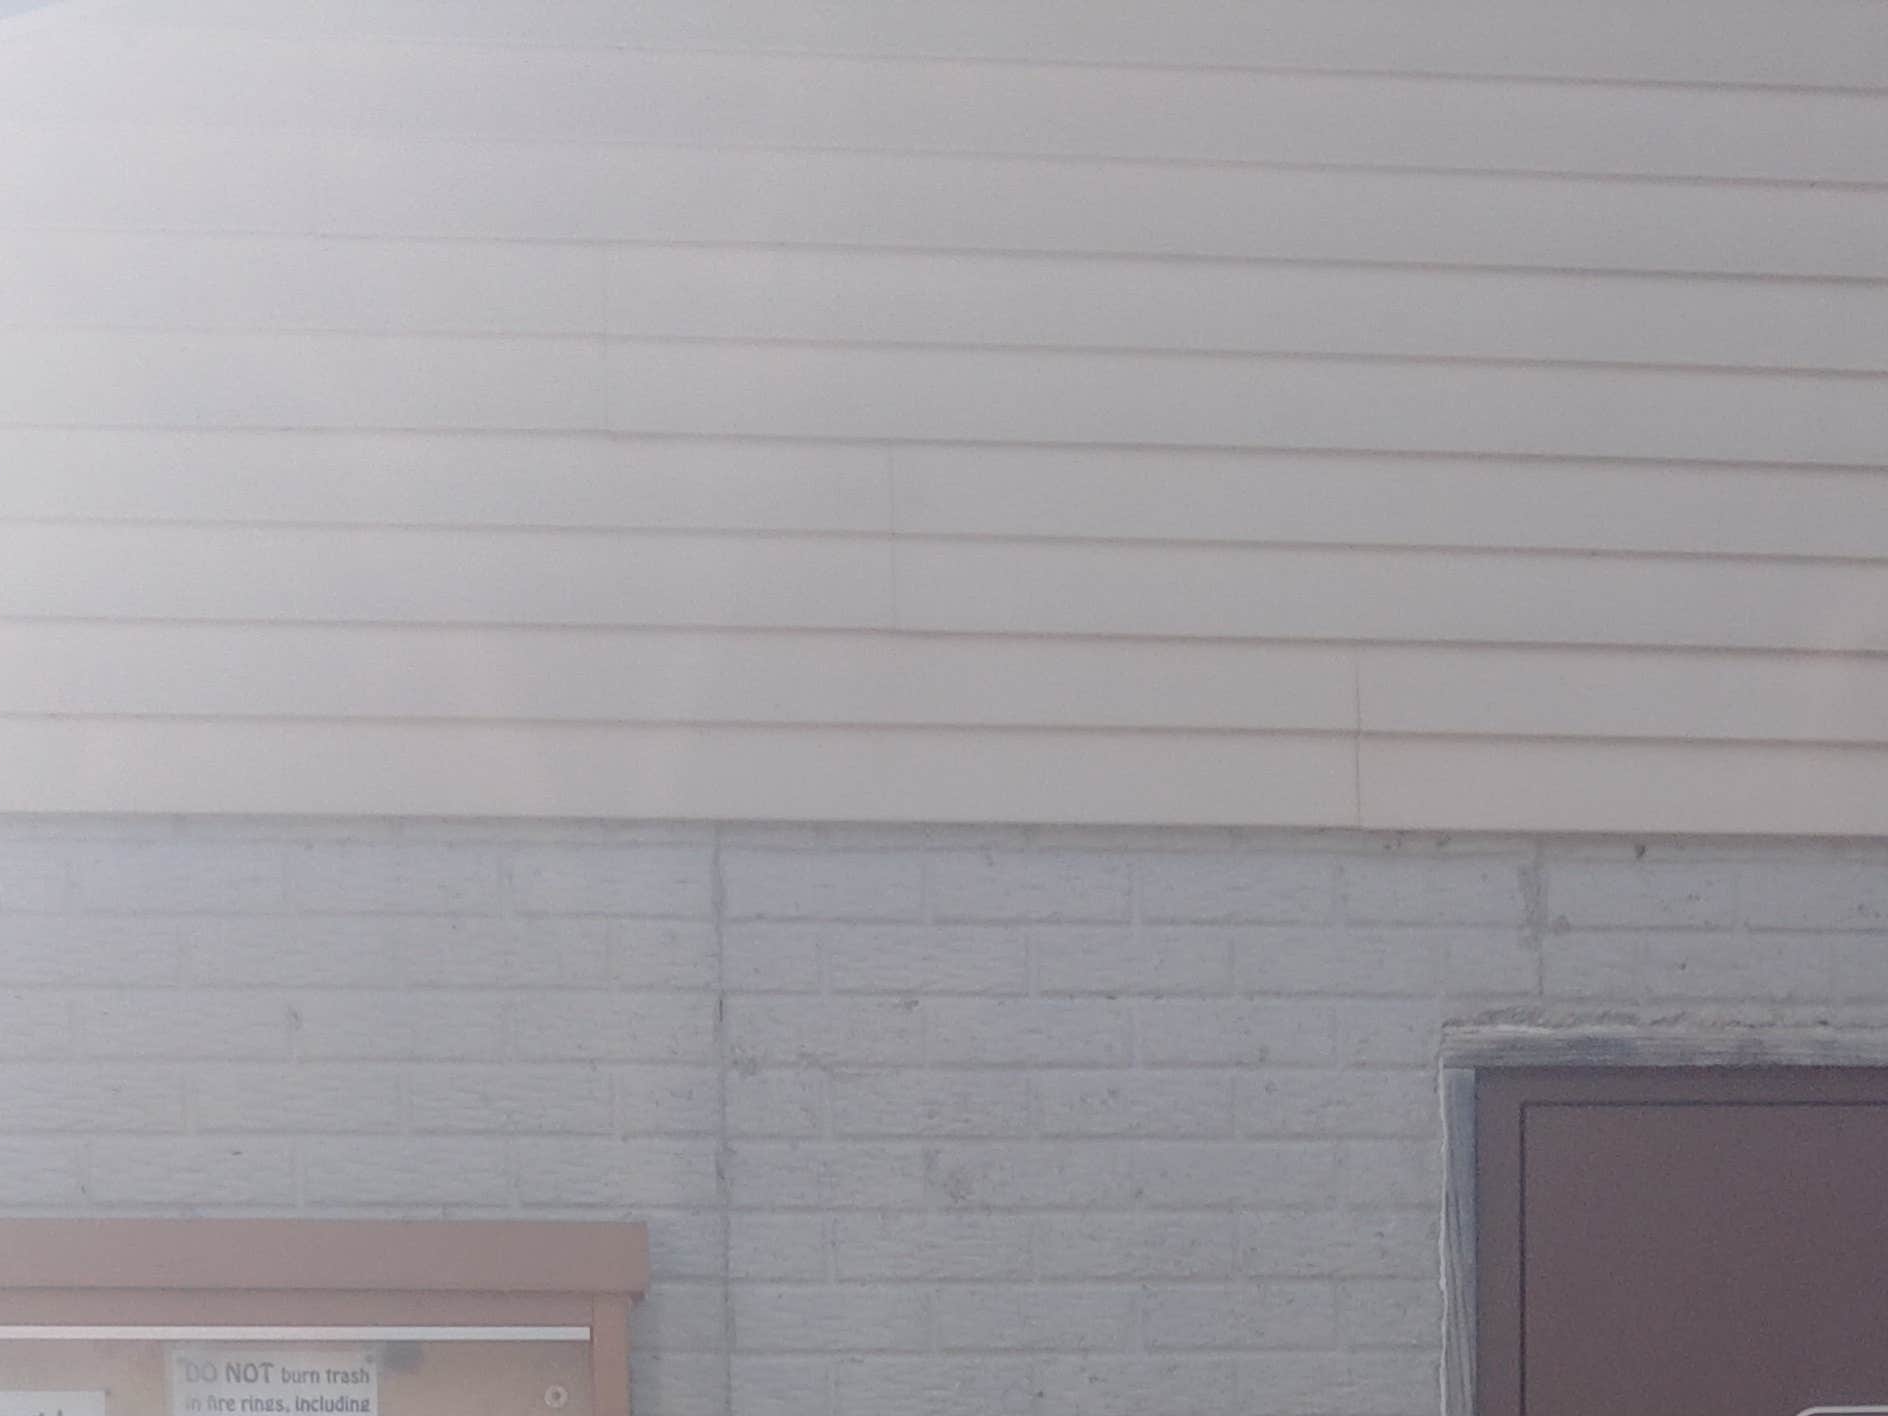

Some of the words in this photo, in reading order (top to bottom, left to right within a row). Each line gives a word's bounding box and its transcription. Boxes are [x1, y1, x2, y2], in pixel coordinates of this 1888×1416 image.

[185, 1362, 217, 1383] DO
[225, 1362, 274, 1384] NOT
[281, 1367, 320, 1384] burn
[326, 1368, 370, 1384] trash
[186, 1397, 200, 1412] in
[208, 1396, 236, 1412] fire
[241, 1396, 290, 1413] rings,
[296, 1396, 370, 1413] including
